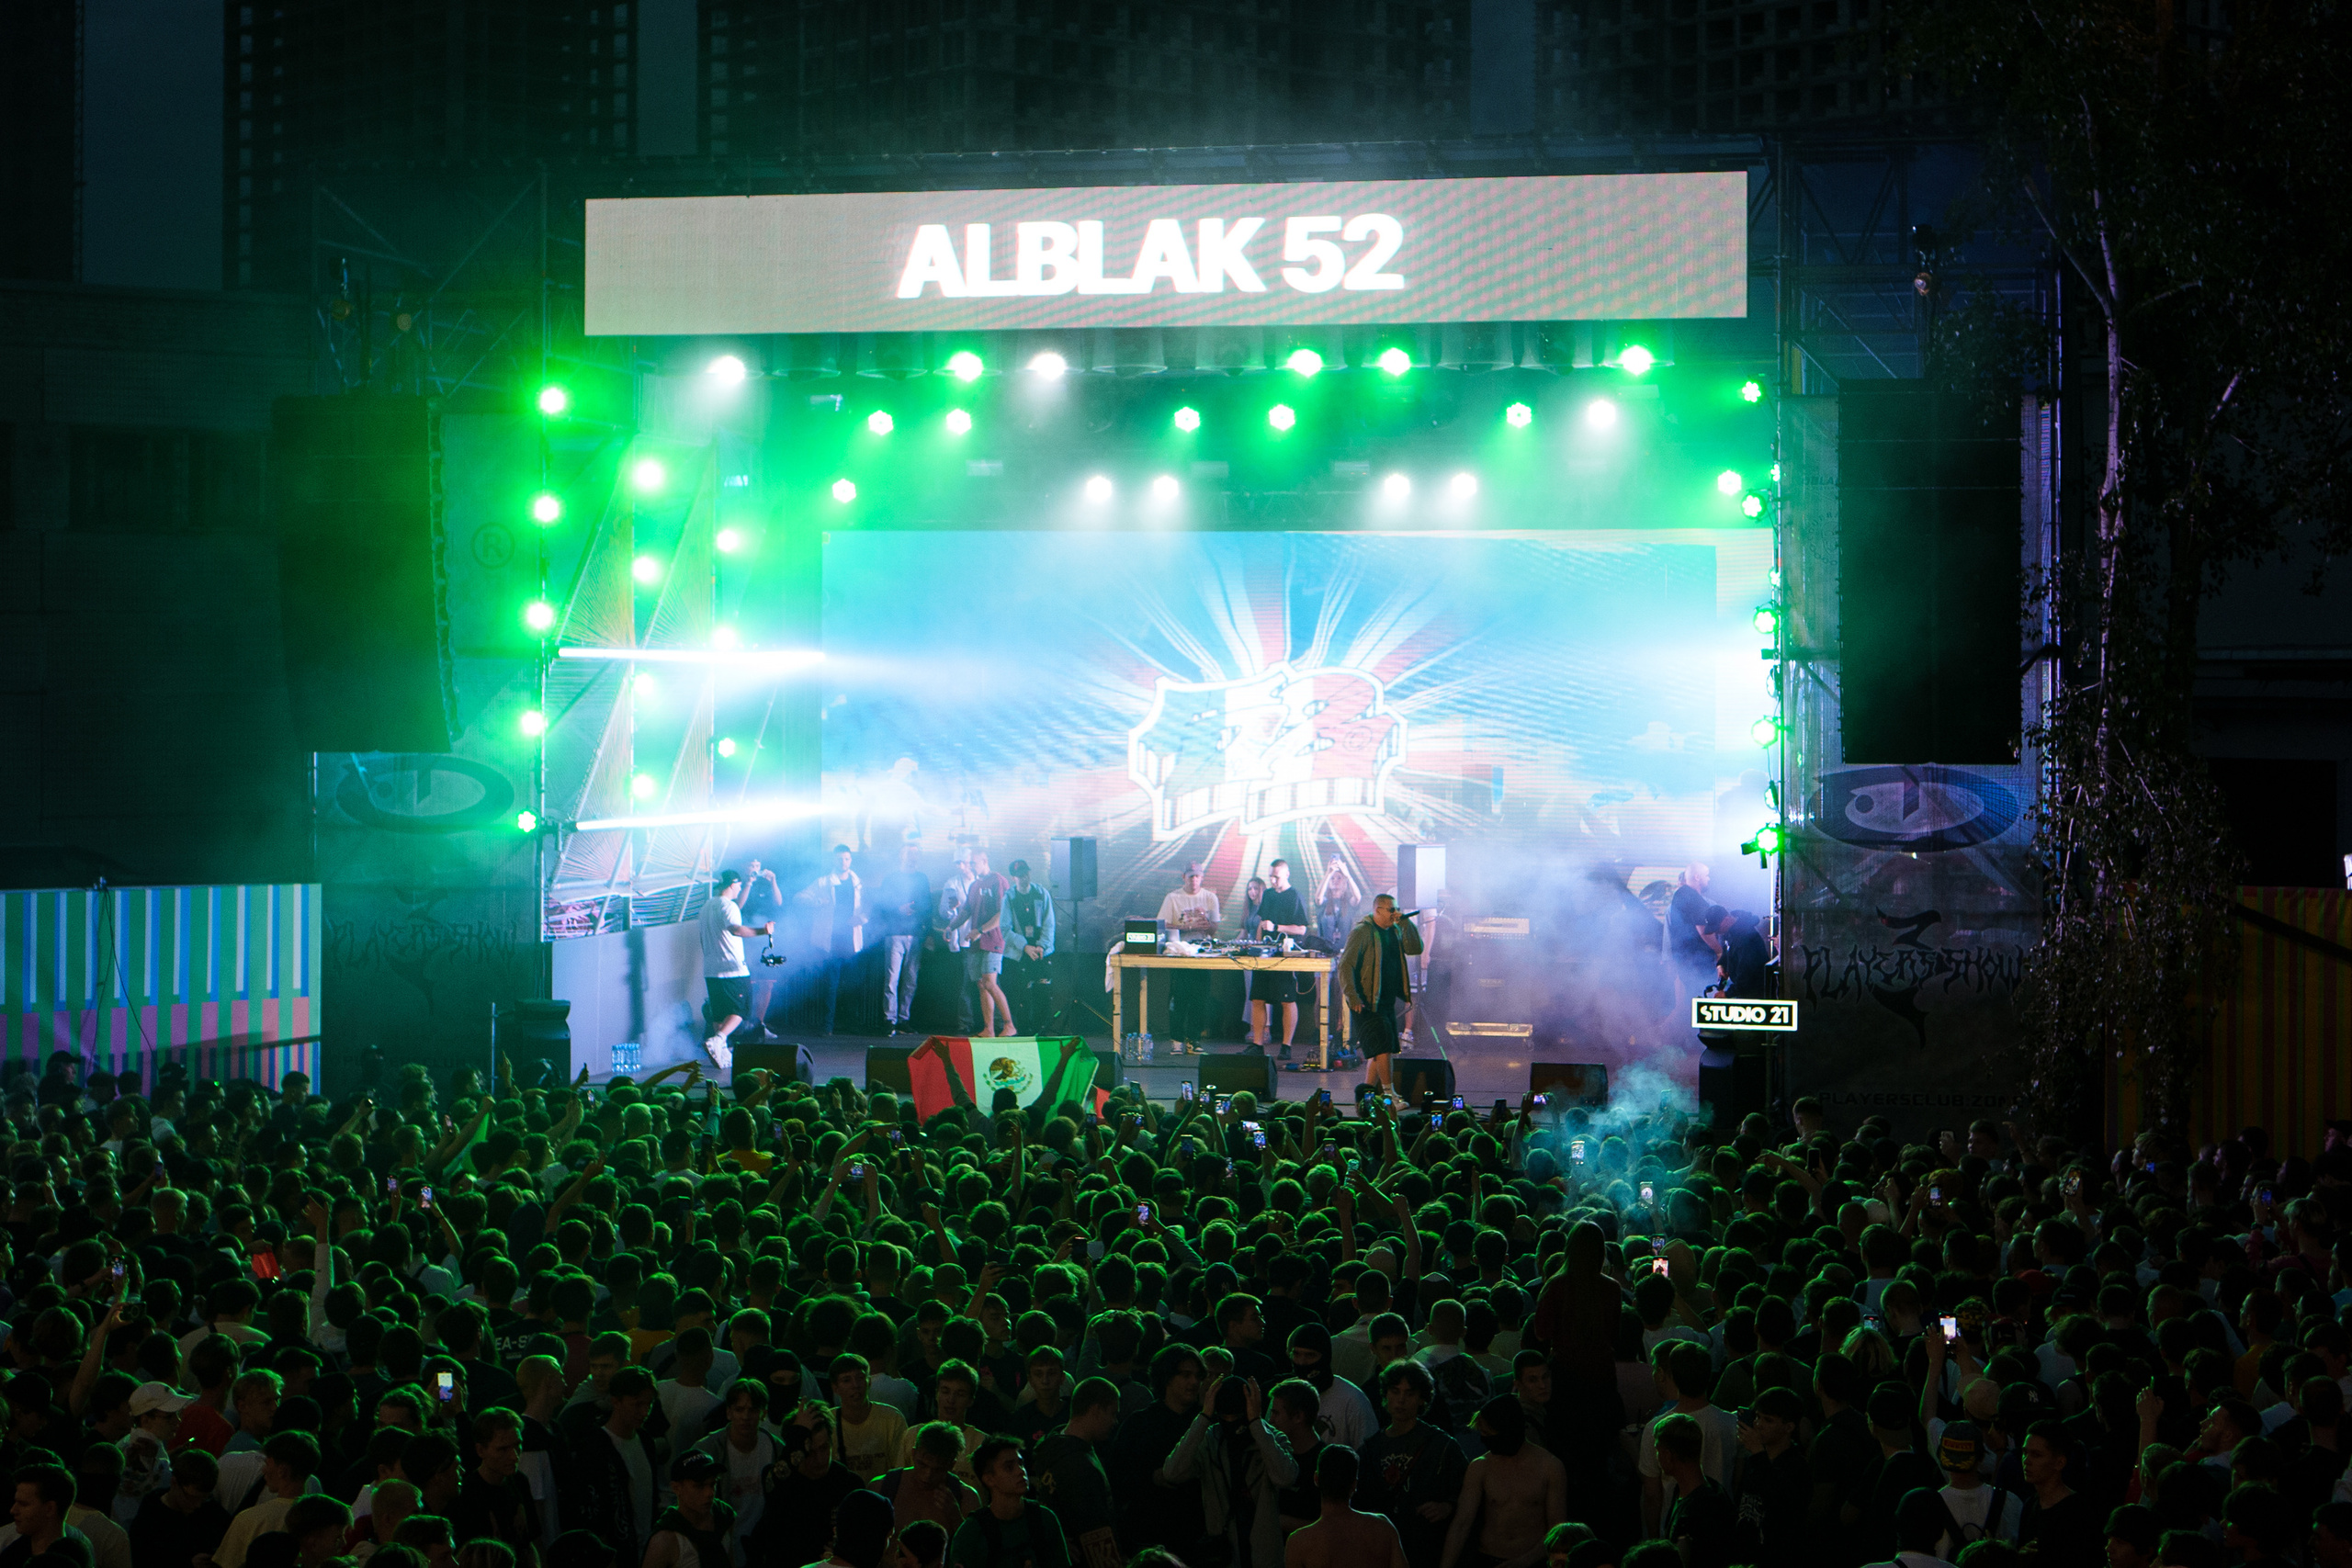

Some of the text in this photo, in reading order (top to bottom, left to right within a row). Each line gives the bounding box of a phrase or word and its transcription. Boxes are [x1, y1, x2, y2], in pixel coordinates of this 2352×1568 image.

[897, 213, 1406, 299] ALBLAK 52
[1700, 1005, 1790, 1024] STUDIO 21
